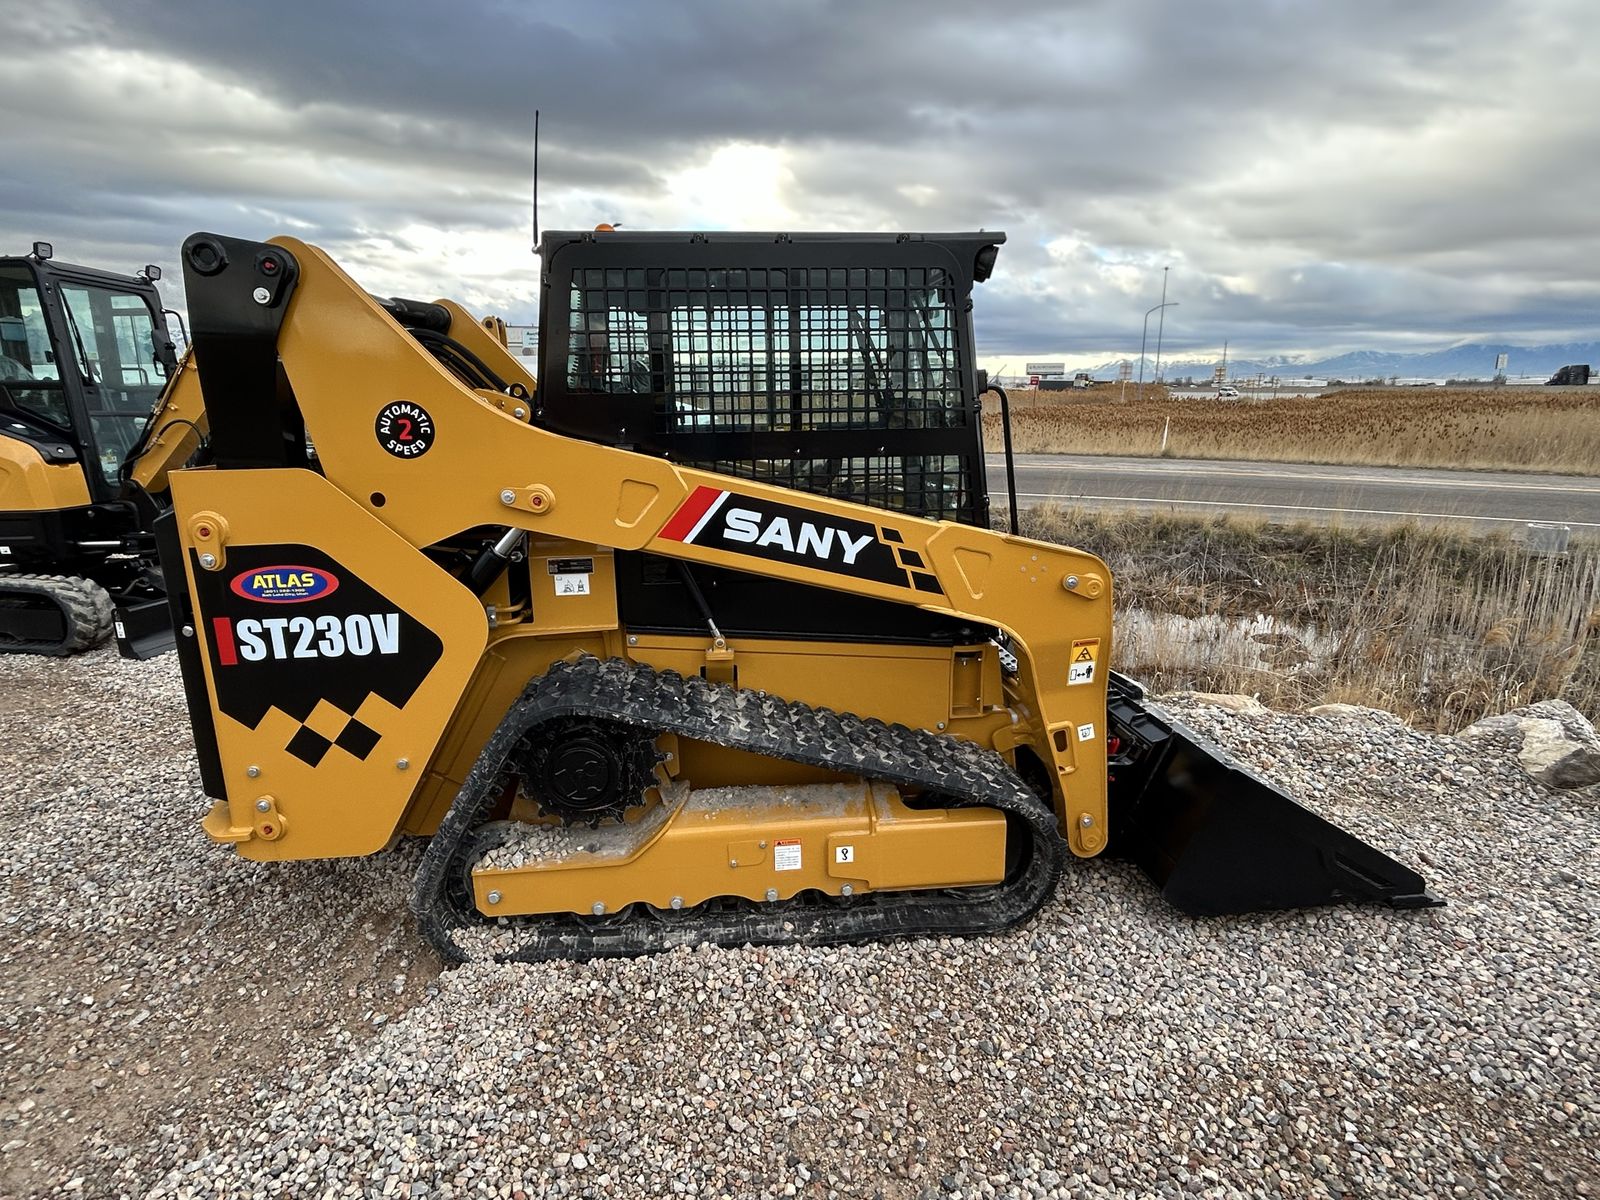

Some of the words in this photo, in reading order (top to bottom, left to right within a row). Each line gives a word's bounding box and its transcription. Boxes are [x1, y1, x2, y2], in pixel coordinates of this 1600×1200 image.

[380, 404, 430, 435] AUTOMATIC
[398, 419, 413, 440] 2
[387, 440, 426, 455] SPEED
[723, 508, 874, 565] SANY
[252, 573, 315, 589] ATLAS
[236, 613, 400, 661] ST230V
